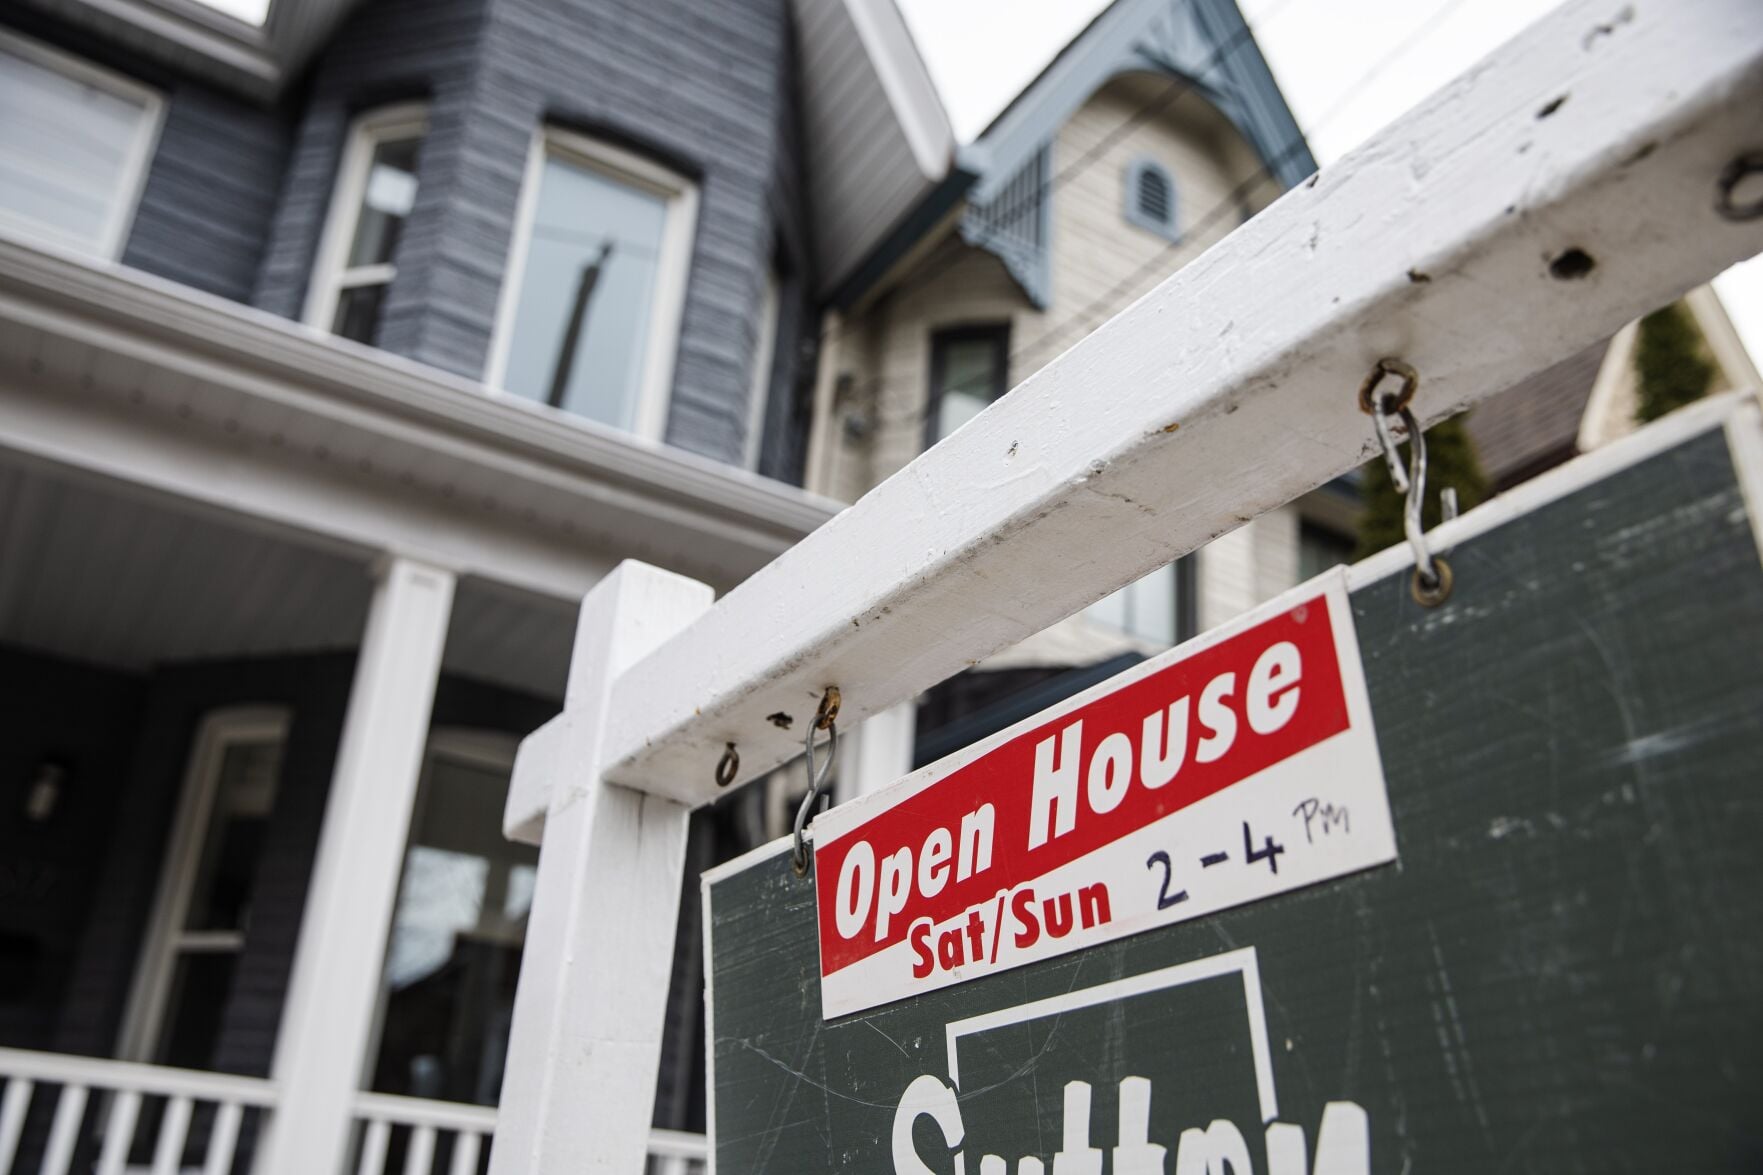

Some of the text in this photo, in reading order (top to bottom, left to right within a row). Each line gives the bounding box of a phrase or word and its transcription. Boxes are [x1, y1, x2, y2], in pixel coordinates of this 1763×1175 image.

[835, 641, 1301, 943] Open House
[910, 882, 1112, 979] Sat/Sun
